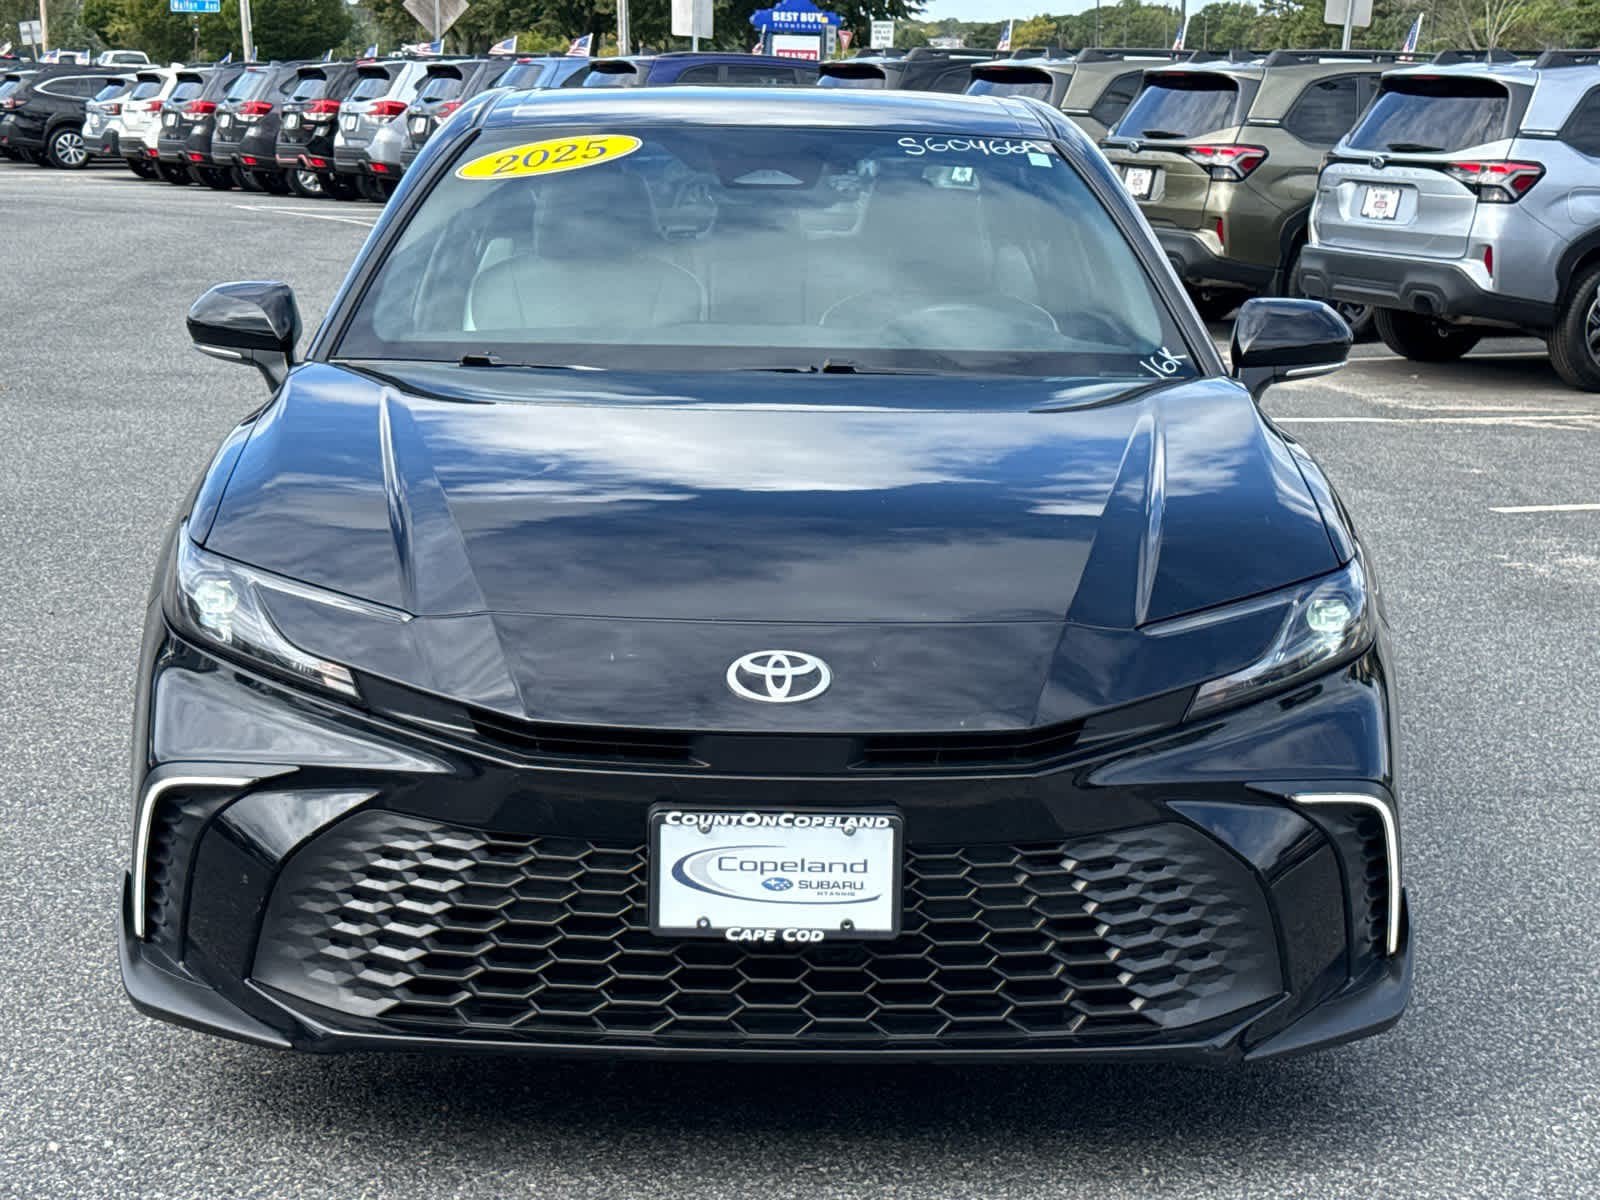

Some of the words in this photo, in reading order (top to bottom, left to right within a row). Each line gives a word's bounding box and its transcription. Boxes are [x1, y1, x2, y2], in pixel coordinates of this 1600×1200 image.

[772, 11, 799, 22] BEST
[800, 12, 824, 23] BUY
[491, 138, 609, 175] 2025
[1139, 346, 1187, 379] 16K
[717, 856, 869, 876] Copeland
[798, 879, 864, 890] SUBARU
[725, 927, 776, 942] CAPE
[782, 928, 825, 943] COD
